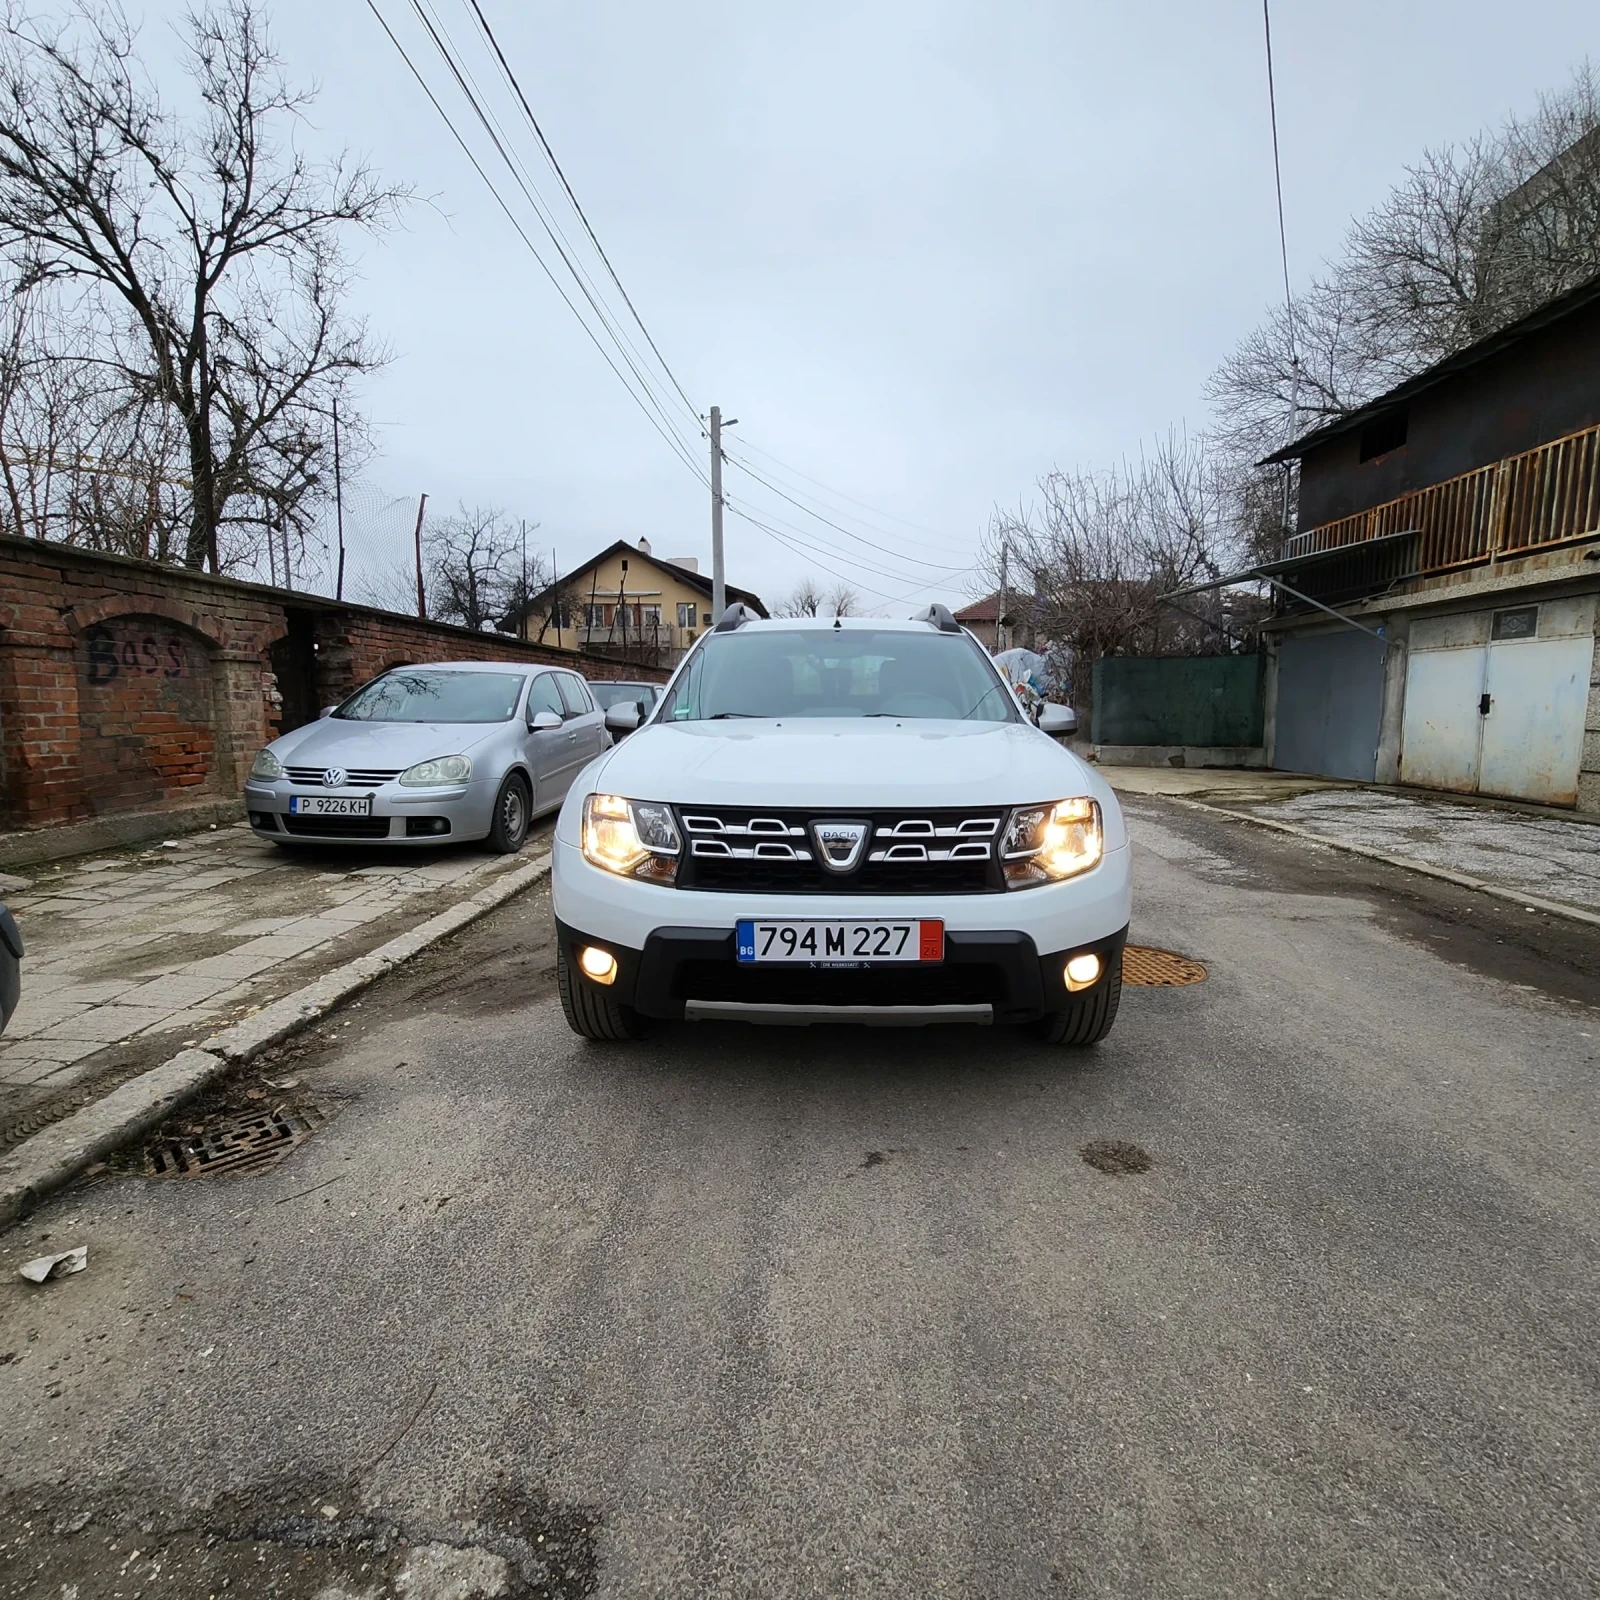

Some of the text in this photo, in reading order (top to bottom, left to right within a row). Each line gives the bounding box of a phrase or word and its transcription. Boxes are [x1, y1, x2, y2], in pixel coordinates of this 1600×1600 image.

[302, 799, 311, 812] P
[317, 800, 348, 813] 9226
[349, 800, 367, 814] KH
[823, 831, 858, 839] DACIA
[759, 926, 911, 957] 794 M 227
[740, 946, 754, 956] BG
[923, 945, 938, 956] 26
